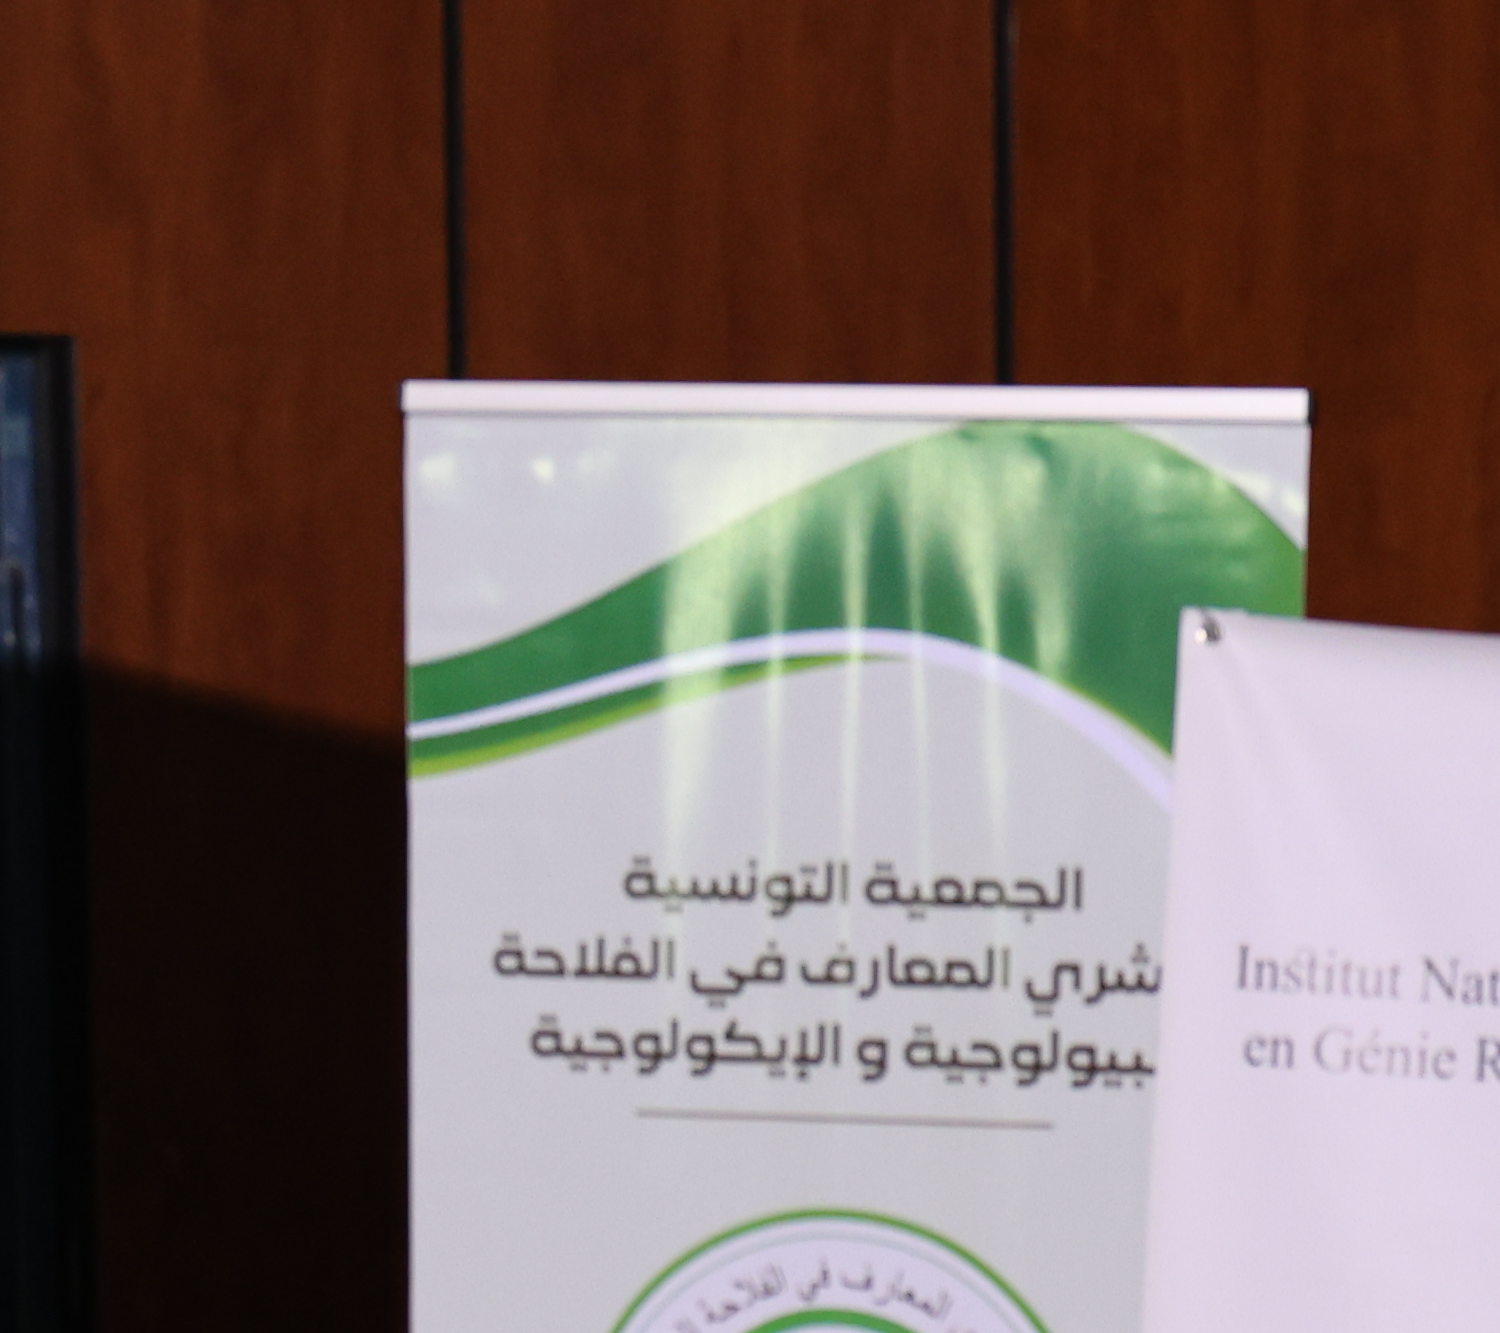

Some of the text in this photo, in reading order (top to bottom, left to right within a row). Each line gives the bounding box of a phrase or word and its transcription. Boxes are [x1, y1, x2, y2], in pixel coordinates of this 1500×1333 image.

[623, 855, 1084, 921] الجمعية التونسية
[492, 932, 675, 982] الفلاحة
[690, 941, 786, 1006] في
[800, 942, 1012, 1000] المعارف
[1236, 945, 1401, 1000] Institut
[1242, 1032, 1296, 1070] en
[1312, 1025, 1458, 1082] Génie
